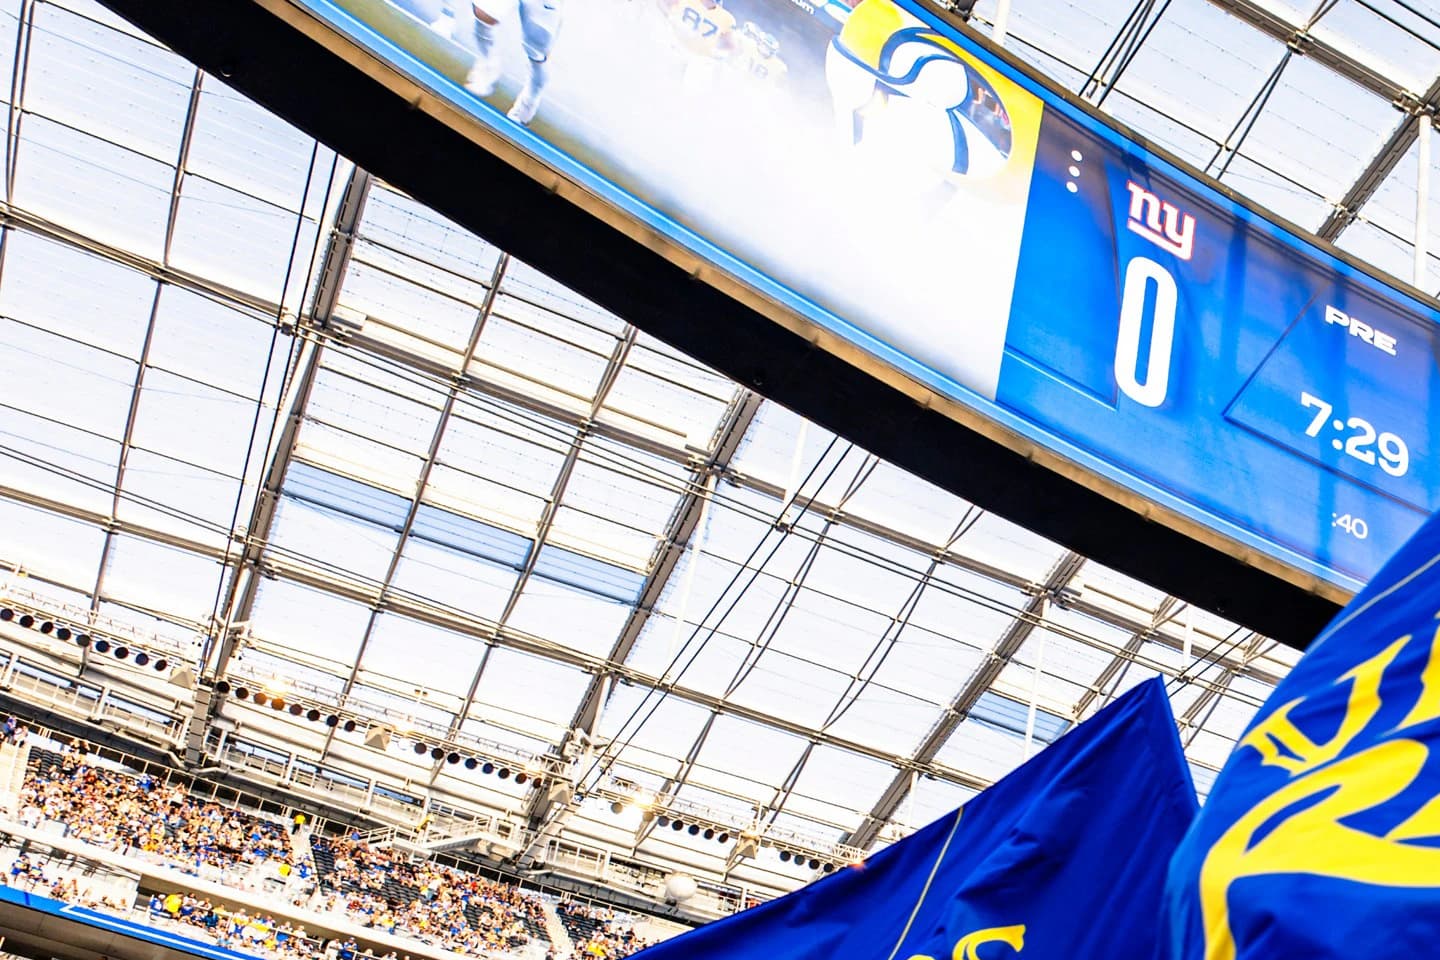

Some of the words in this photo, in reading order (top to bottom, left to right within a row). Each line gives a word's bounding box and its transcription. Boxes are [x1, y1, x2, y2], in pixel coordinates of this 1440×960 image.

[1115, 256, 1178, 408] 0
[1325, 305, 1397, 356] PRE
[1301, 392, 1409, 477] 7:29
[1331, 512, 1368, 540] :40
